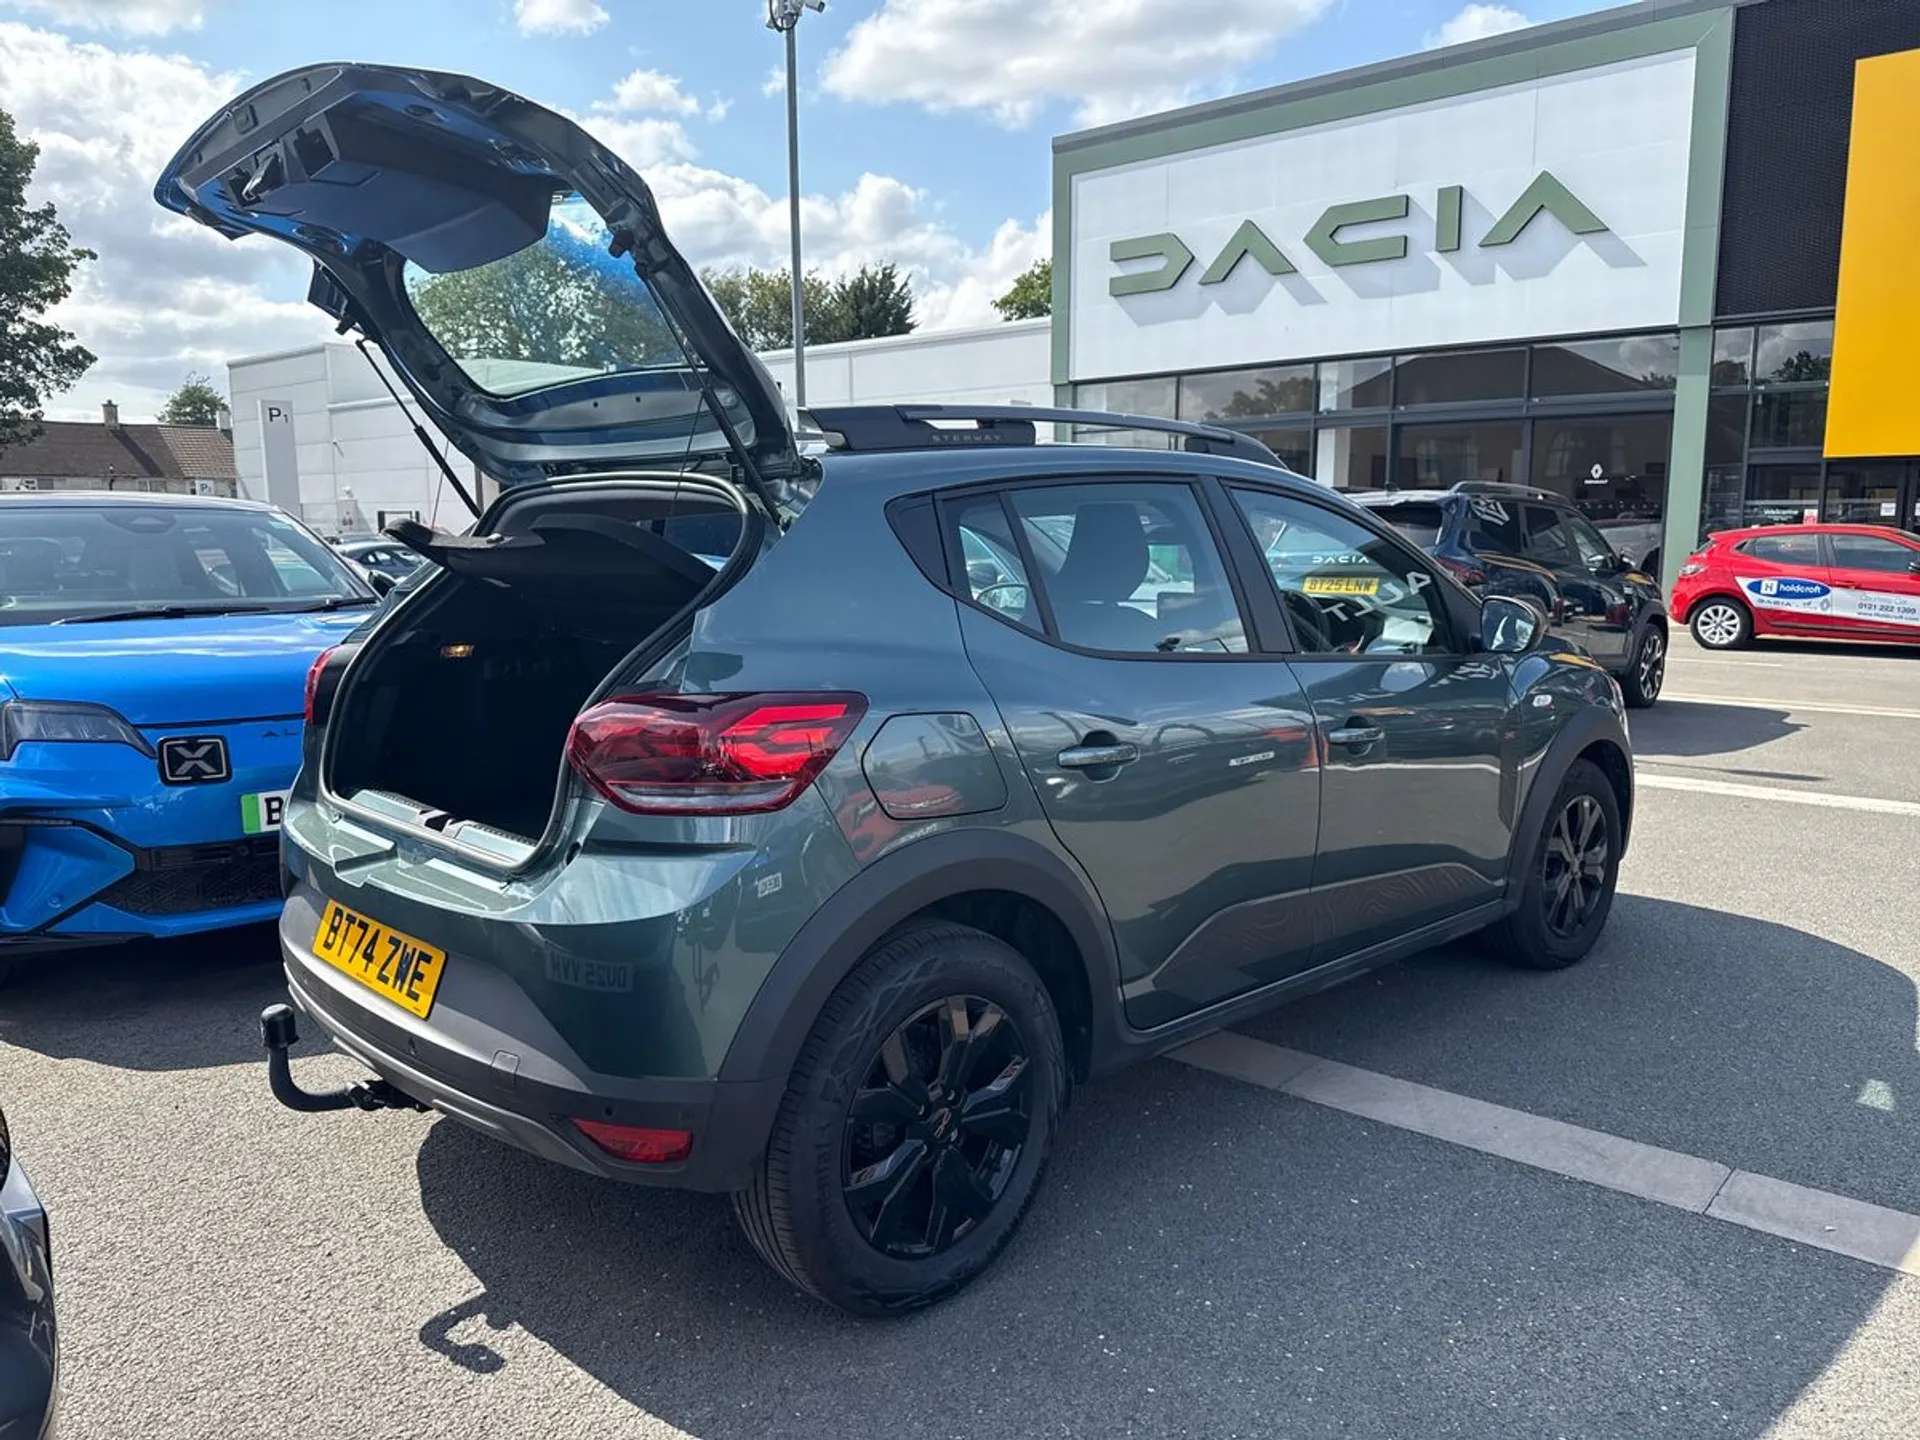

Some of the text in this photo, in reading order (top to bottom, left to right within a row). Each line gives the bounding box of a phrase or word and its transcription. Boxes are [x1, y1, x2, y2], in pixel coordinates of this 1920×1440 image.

[1110, 169, 1609, 297] DACIA
[1312, 555, 1370, 564] DACIA
[1779, 583, 1822, 594] holdcroft
[323, 906, 433, 1002] BT74 ZWE
